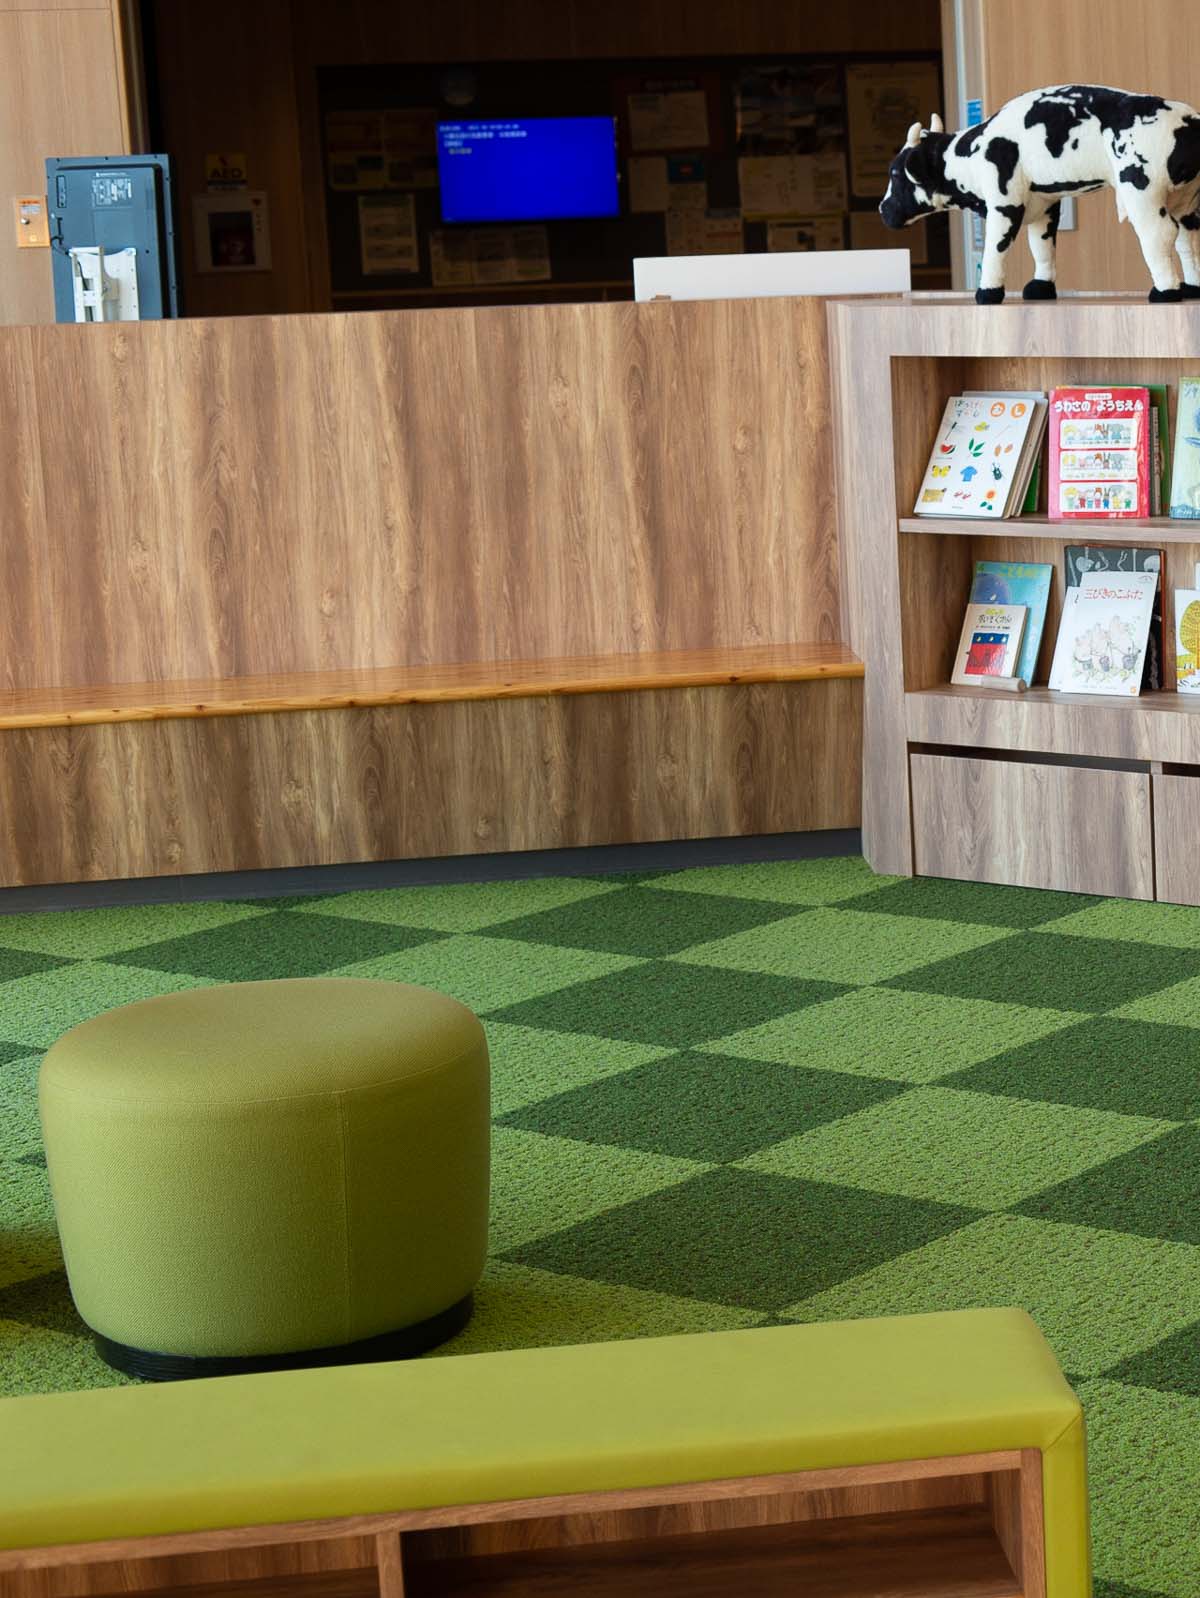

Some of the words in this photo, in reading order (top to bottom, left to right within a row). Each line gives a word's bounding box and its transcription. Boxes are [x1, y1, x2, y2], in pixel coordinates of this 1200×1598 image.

[1096, 400, 1144, 412] ようちえん
